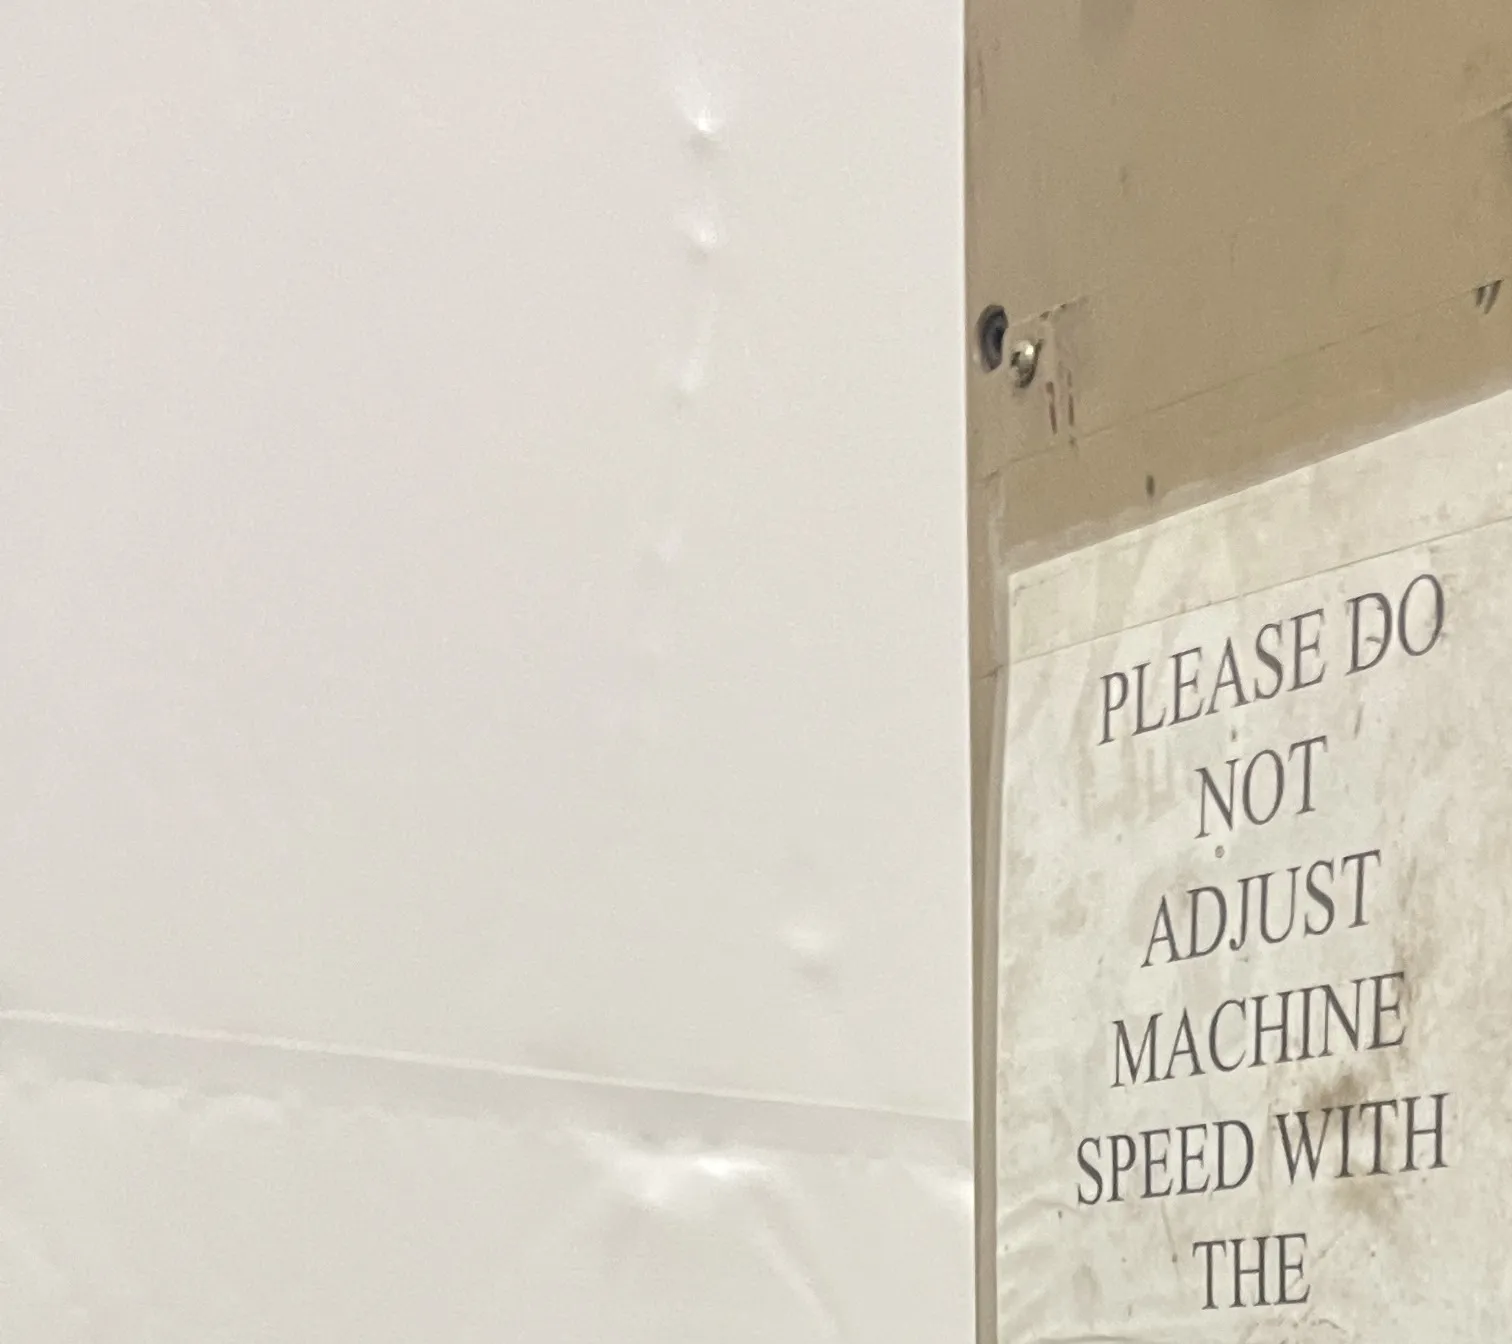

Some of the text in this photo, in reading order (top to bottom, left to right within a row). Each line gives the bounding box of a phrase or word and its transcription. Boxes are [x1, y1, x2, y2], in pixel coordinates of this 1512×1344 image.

[1097, 572, 1446, 746] PLEASE DO
[1194, 735, 1328, 839] NOT
[1140, 849, 1382, 968] ADJUST
[1110, 971, 1407, 1088] MACHINE
[1076, 1092, 1451, 1207] SPEED WITH
[1192, 1233, 1312, 1311] THE
